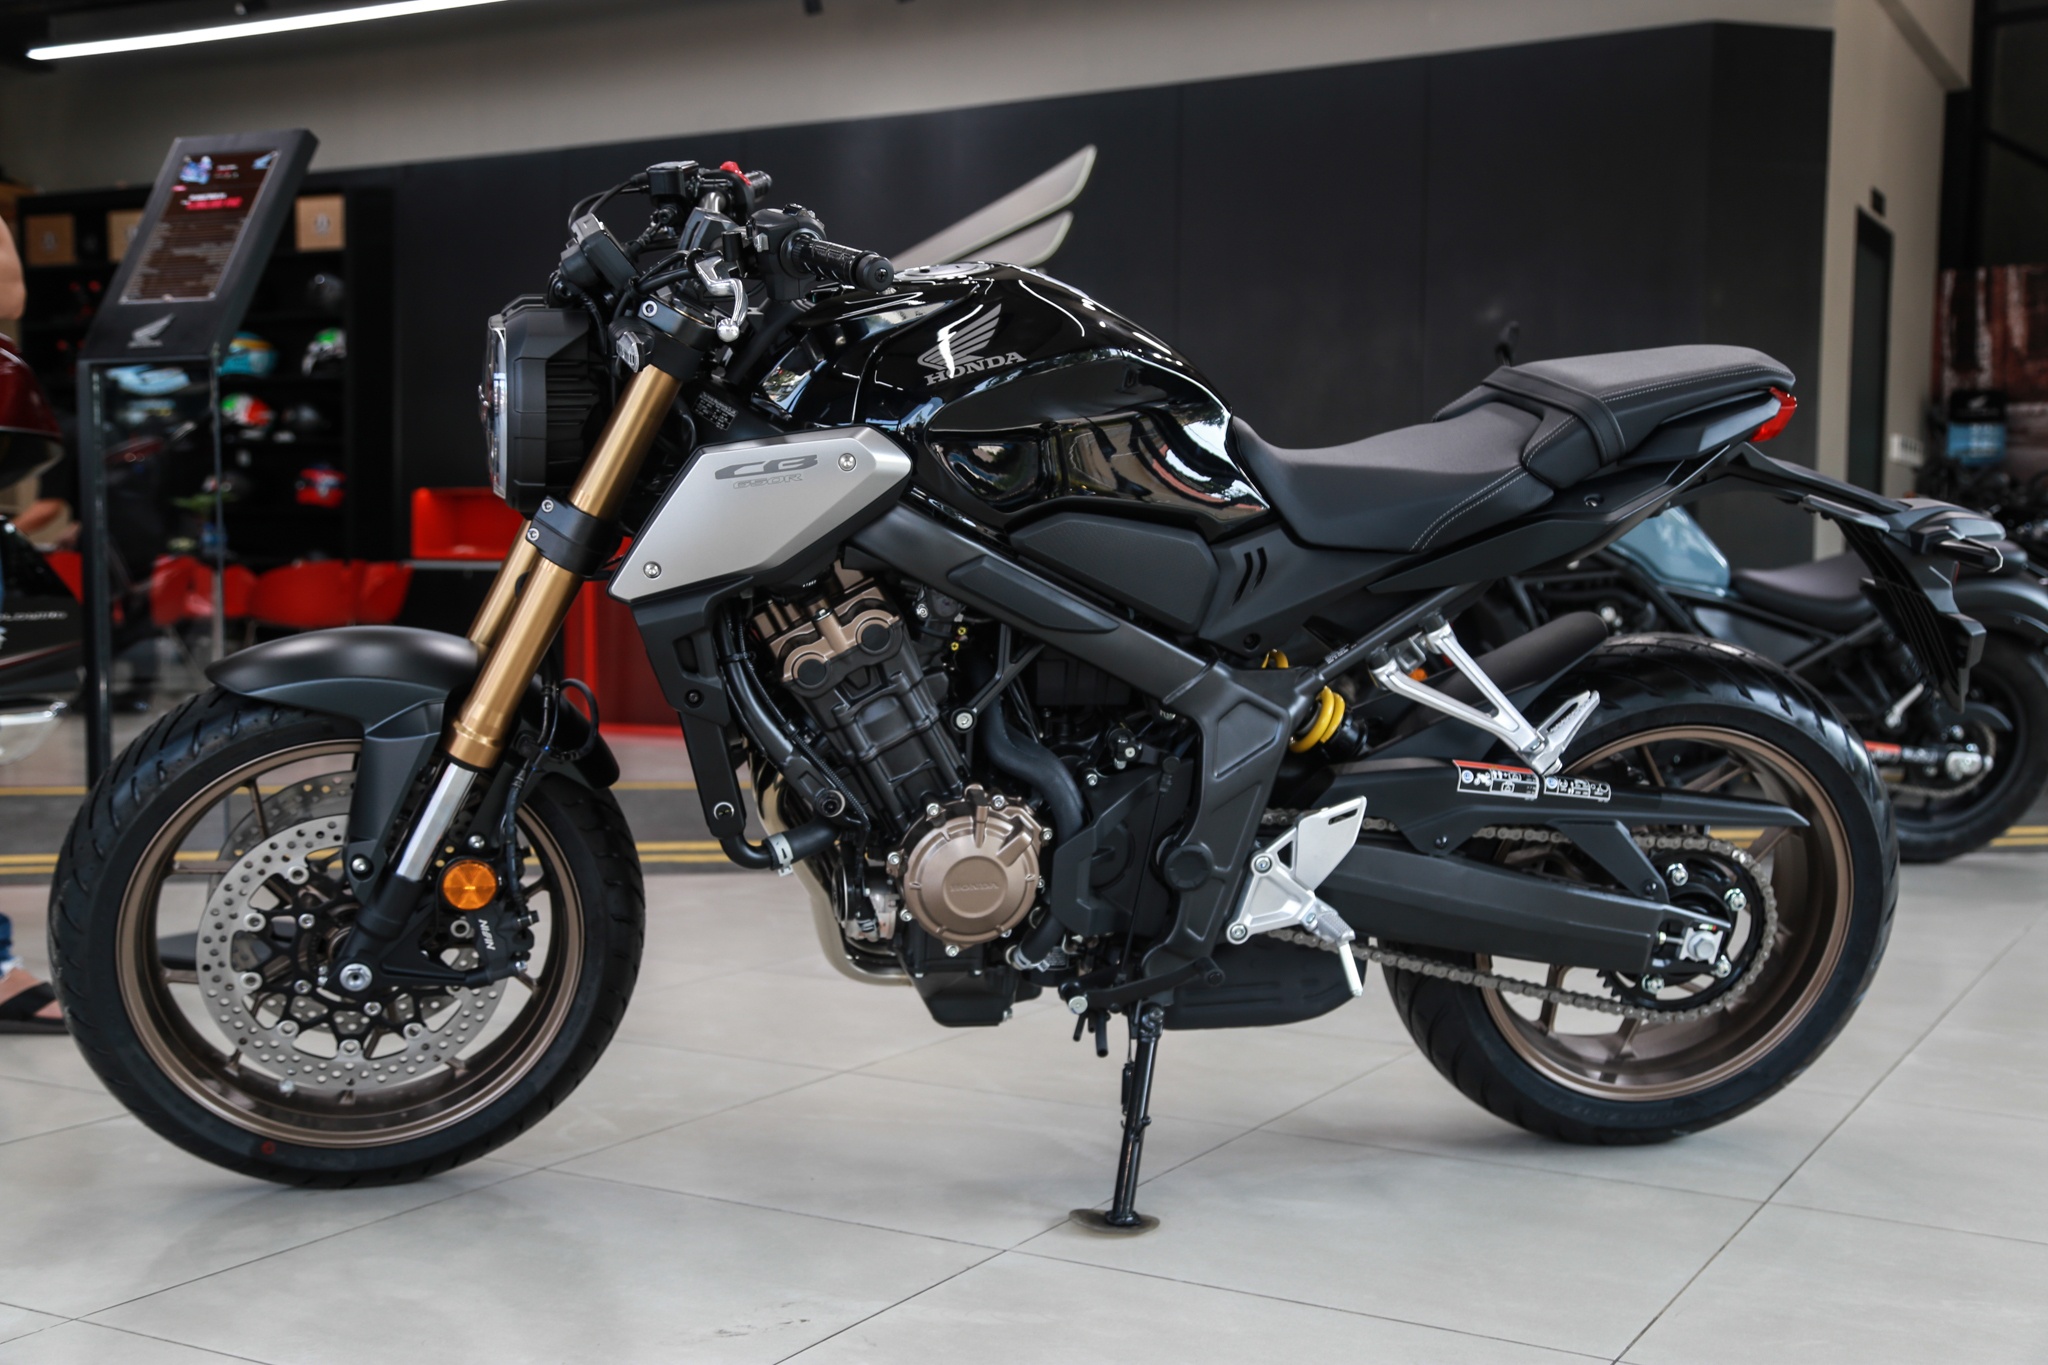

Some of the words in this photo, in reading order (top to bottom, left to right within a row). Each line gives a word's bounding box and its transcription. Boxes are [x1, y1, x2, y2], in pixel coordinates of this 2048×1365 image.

[924, 351, 1027, 386] HONDA
[715, 454, 818, 480] CB
[733, 473, 803, 489] 650R
[950, 882, 999, 892] HONDA
